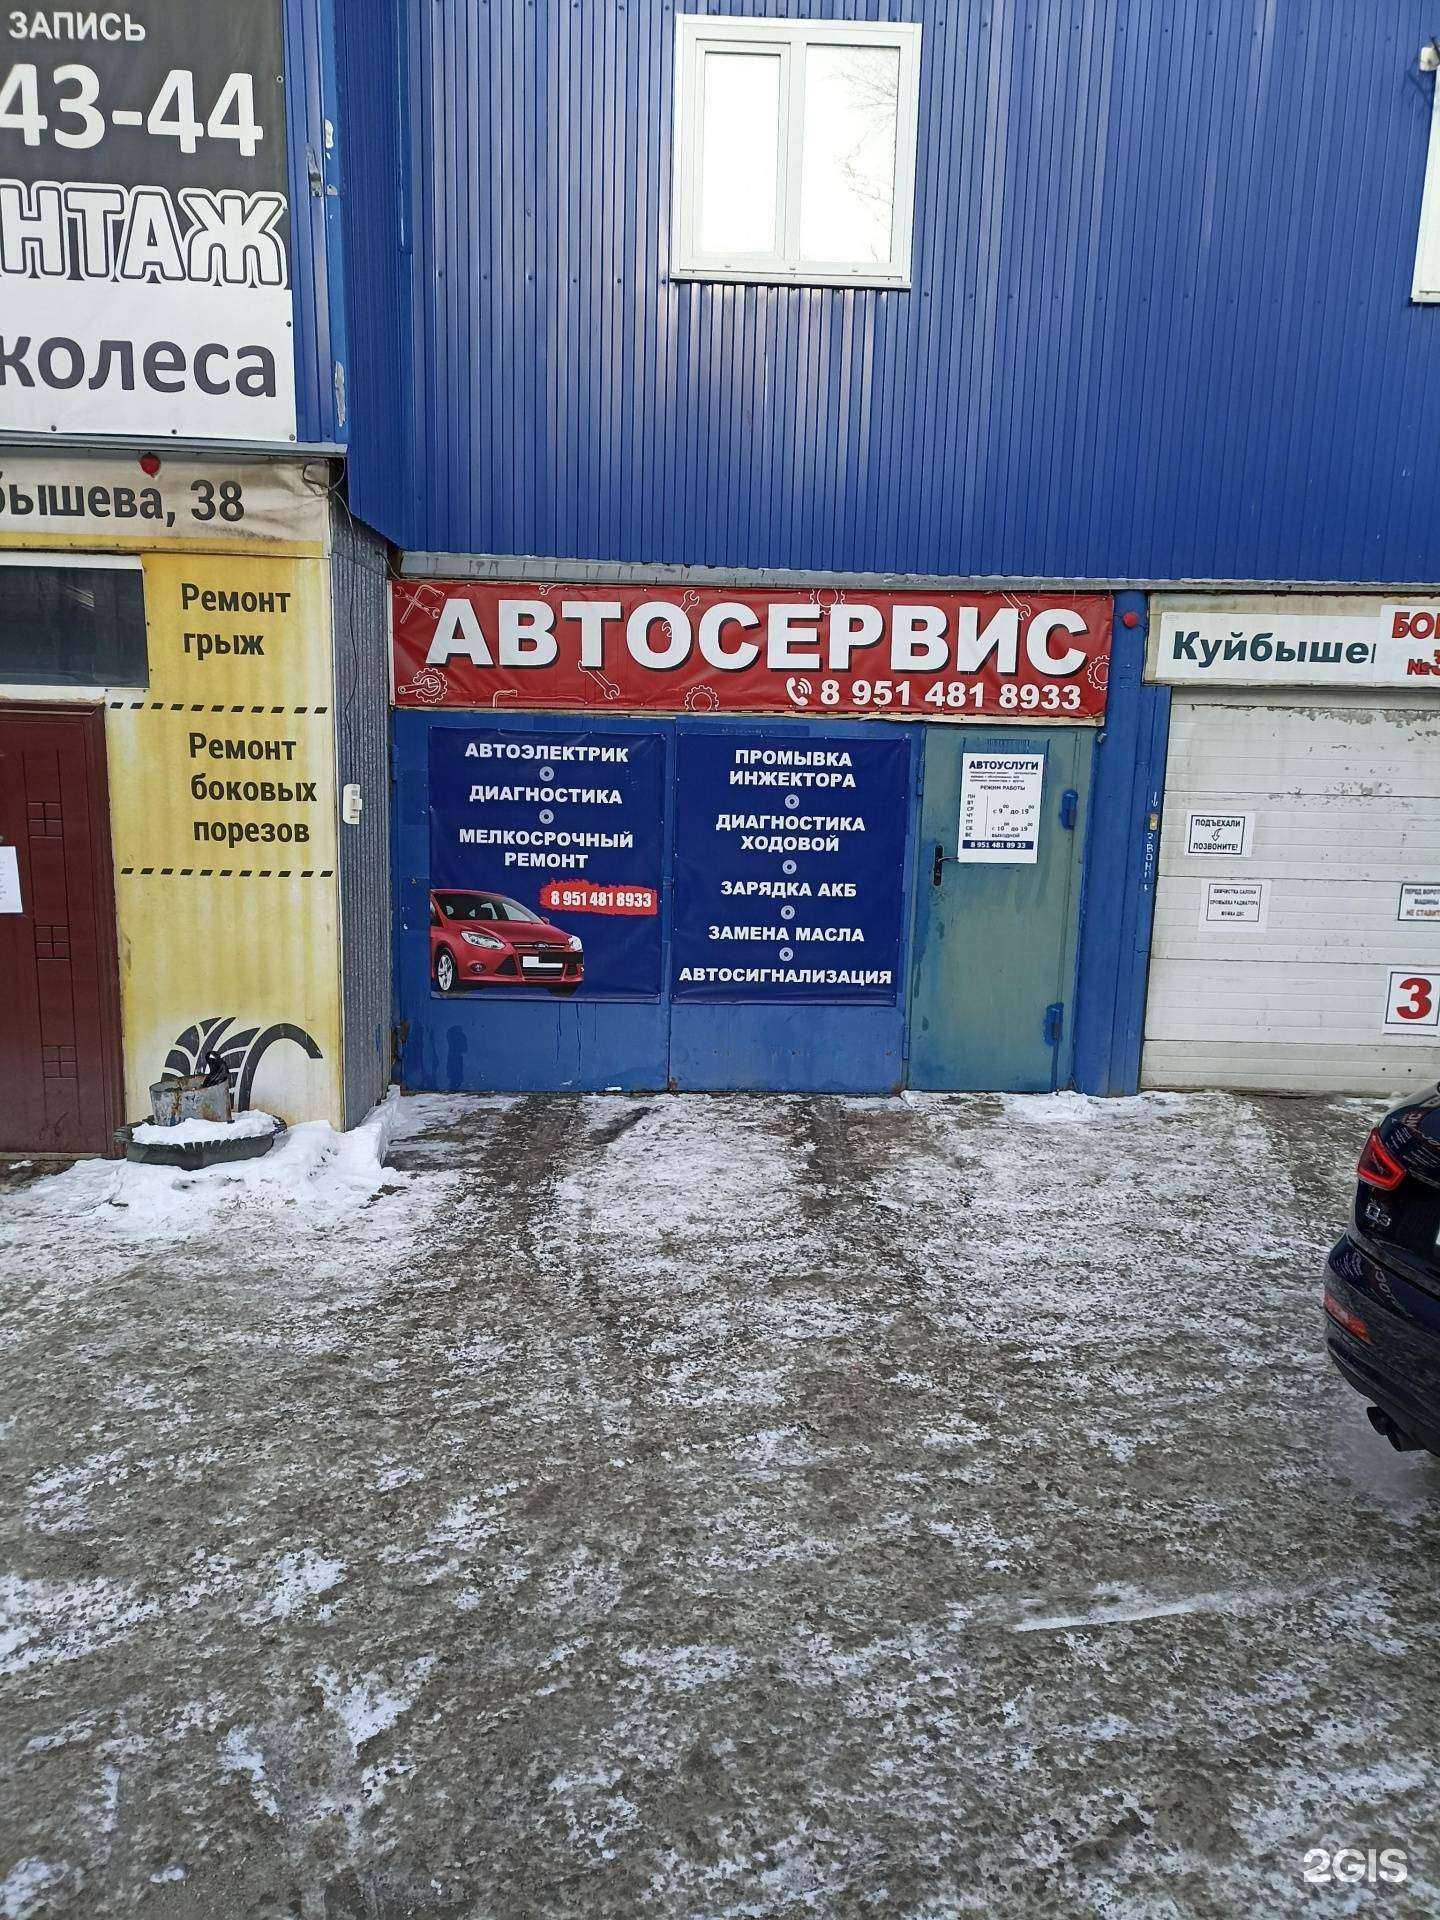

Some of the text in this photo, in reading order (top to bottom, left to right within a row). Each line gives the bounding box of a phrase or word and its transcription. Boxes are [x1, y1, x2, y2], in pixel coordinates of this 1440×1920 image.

[8, 11, 146, 42] ЗАПИСЬ
[0, 63, 264, 157] 43-44
[0, 180, 288, 289] НТАЖ
[0, 335, 277, 398] колеса
[0, 471, 245, 527] ышева, 38
[181, 583, 291, 613] Ремонт
[183, 632, 265, 660] грыж
[425, 598, 1090, 677] АВТОСЕРВИС
[1172, 630, 1376, 668] Куйбыше
[820, 680, 1081, 709] 8 951 481 8933
[189, 732, 297, 760] Ремонт
[465, 742, 628, 763] АВТОЭЛЕКТРИК
[735, 749, 852, 767] ПРОМЫВКА
[969, 760, 1039, 770] АВТОУСЛУГИ
[191, 773, 317, 802] боковых
[729, 770, 856, 788] ИНЖЕКТОРА
[469, 785, 622, 804] ДИАГНОСТИКА
[715, 814, 866, 832] ДИАГНОСТИКА
[1195, 819, 1240, 828] ПОДЪЕХАЛИ
[194, 820, 310, 848] порезов
[459, 828, 633, 848] МЕЛКОСРОЧНЫЙ
[741, 834, 839, 852] ХОДОВОЙ
[1193, 842, 1238, 851] ПОЗВОНИТЕ!
[504, 852, 588, 869] РЕМОНТ
[550, 890, 652, 908] 8 951 481 8933
[720, 881, 857, 898] ЗАРЯДКА АКБ
[708, 925, 865, 942] ЗАМЕНА МАСЛА
[679, 967, 892, 986] АВТОСИГНАЛИЗАЦИЯ
[1396, 977, 1432, 1019] 3
